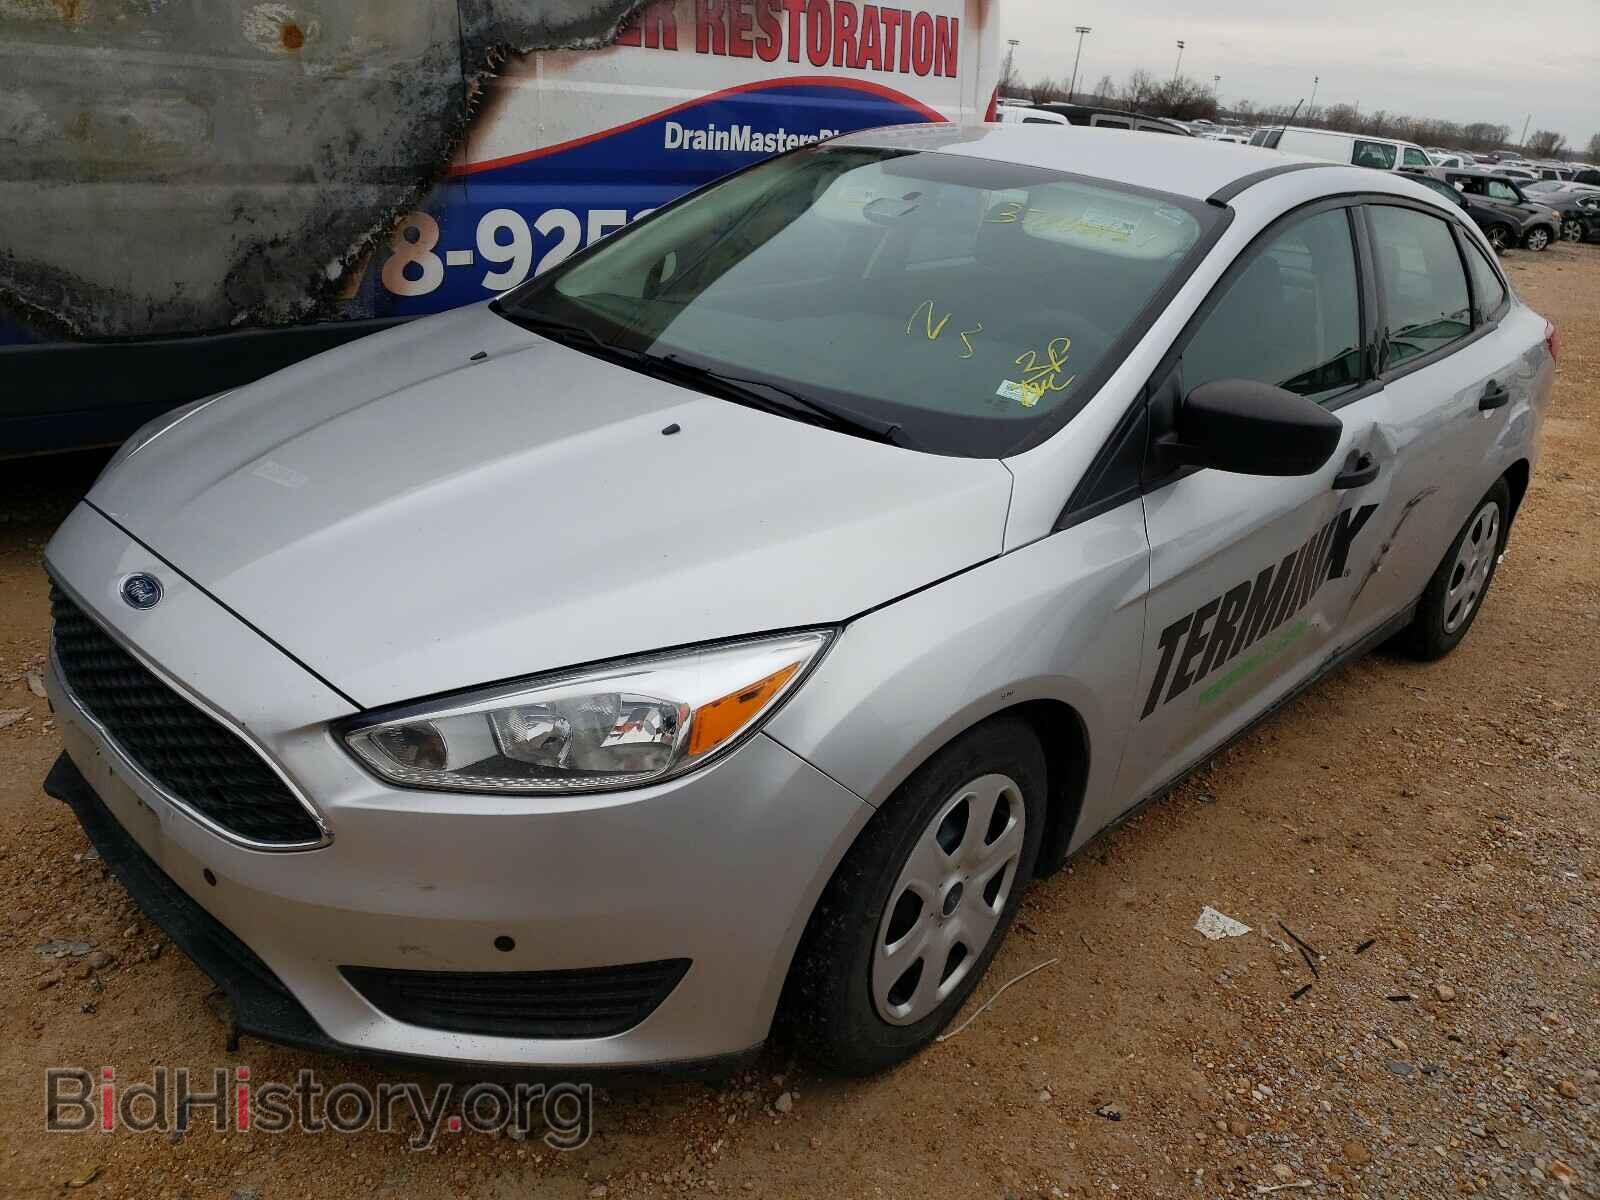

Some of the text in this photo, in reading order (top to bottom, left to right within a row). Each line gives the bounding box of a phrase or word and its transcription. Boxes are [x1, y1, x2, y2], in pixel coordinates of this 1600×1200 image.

[695, 0, 960, 78] RESTORATION
[664, 121, 840, 153] DrainMaster
[1140, 503, 1380, 721] TERMINIX
